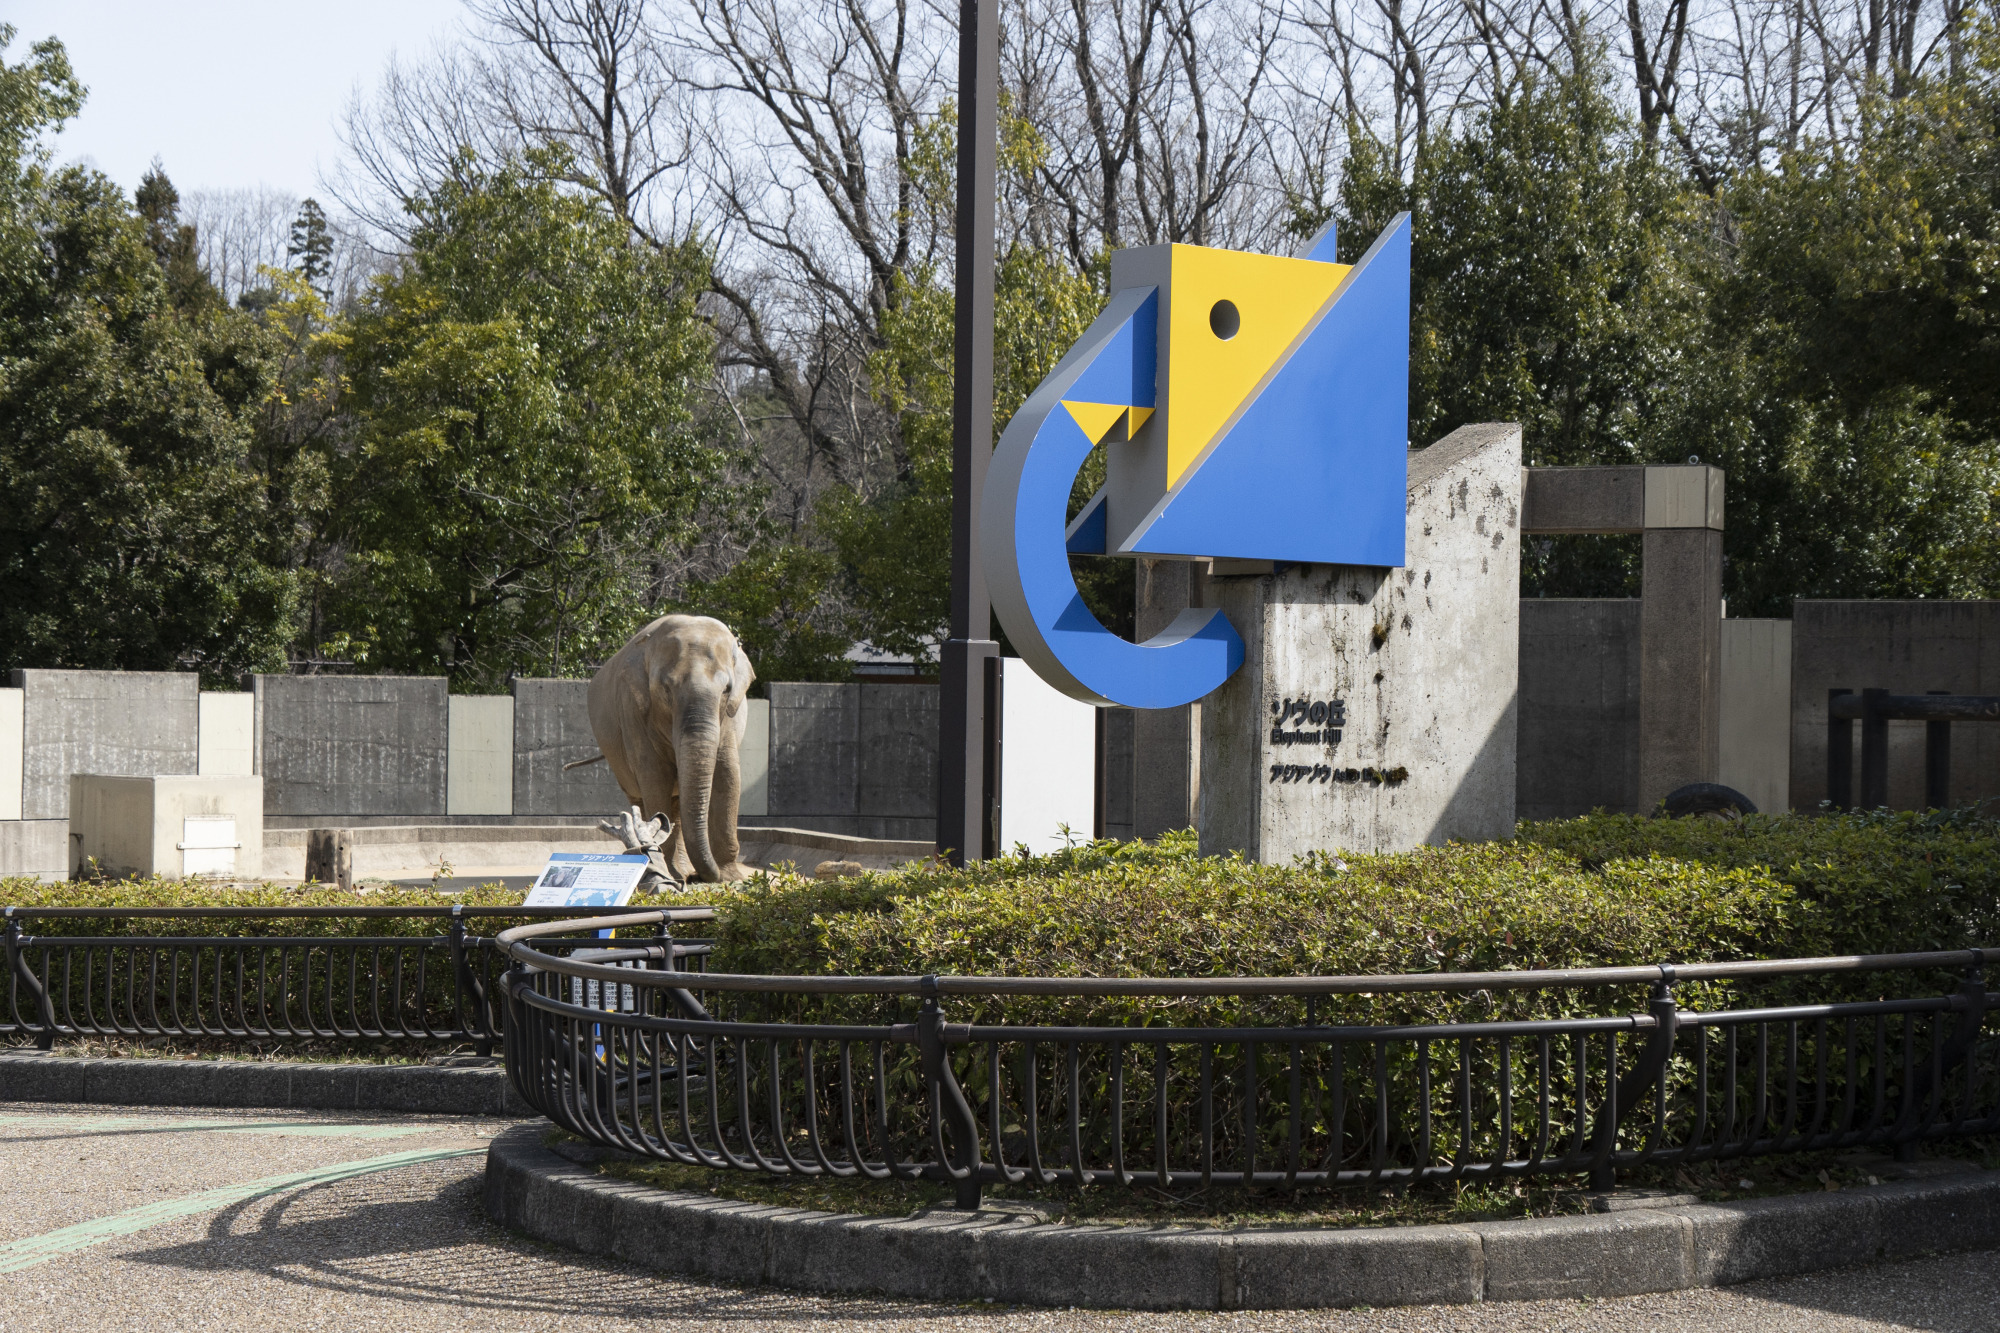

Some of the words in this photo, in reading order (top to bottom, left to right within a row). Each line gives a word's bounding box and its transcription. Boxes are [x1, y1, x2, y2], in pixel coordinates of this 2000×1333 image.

[1271, 698, 1346, 726] ゾウの丘
[1271, 728, 1321, 747] Elephant
[1323, 729, 1342, 745] Hill
[1270, 763, 1331, 783] アジアゾウ
[581, 854, 615, 862] アジアゾウ
